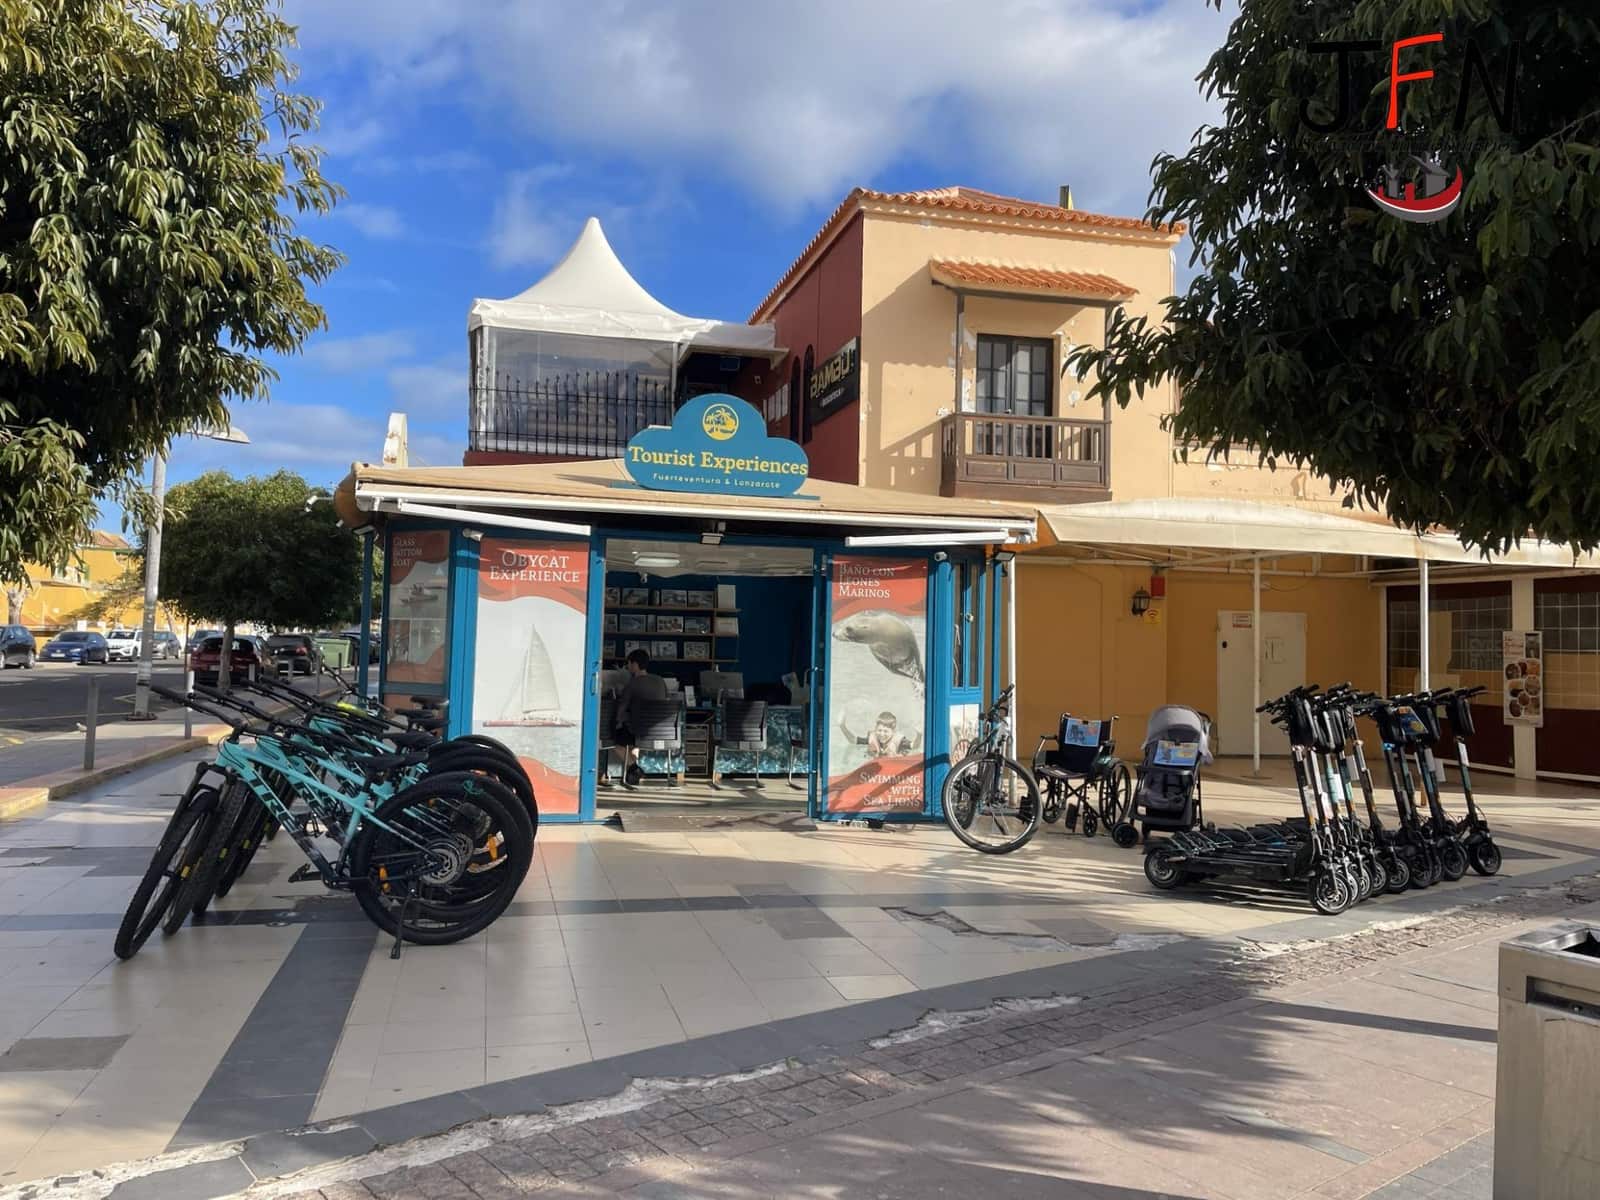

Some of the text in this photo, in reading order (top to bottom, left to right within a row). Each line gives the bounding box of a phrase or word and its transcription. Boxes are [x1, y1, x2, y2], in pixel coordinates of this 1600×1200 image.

[629, 446, 808, 475] Tourist Experiences
[653, 473, 720, 485] Fuerteventura
[734, 478, 780, 489] Lanzarote
[502, 551, 569, 569] OBYCAT
[490, 565, 579, 583] EXPERIENCE
[872, 568, 895, 577] CON
[839, 574, 880, 587] LEONES
[839, 585, 890, 599] MARINOS
[860, 771, 920, 785] SWIMMING
[891, 785, 920, 795] WITH
[863, 795, 920, 807] SEA LIONS
